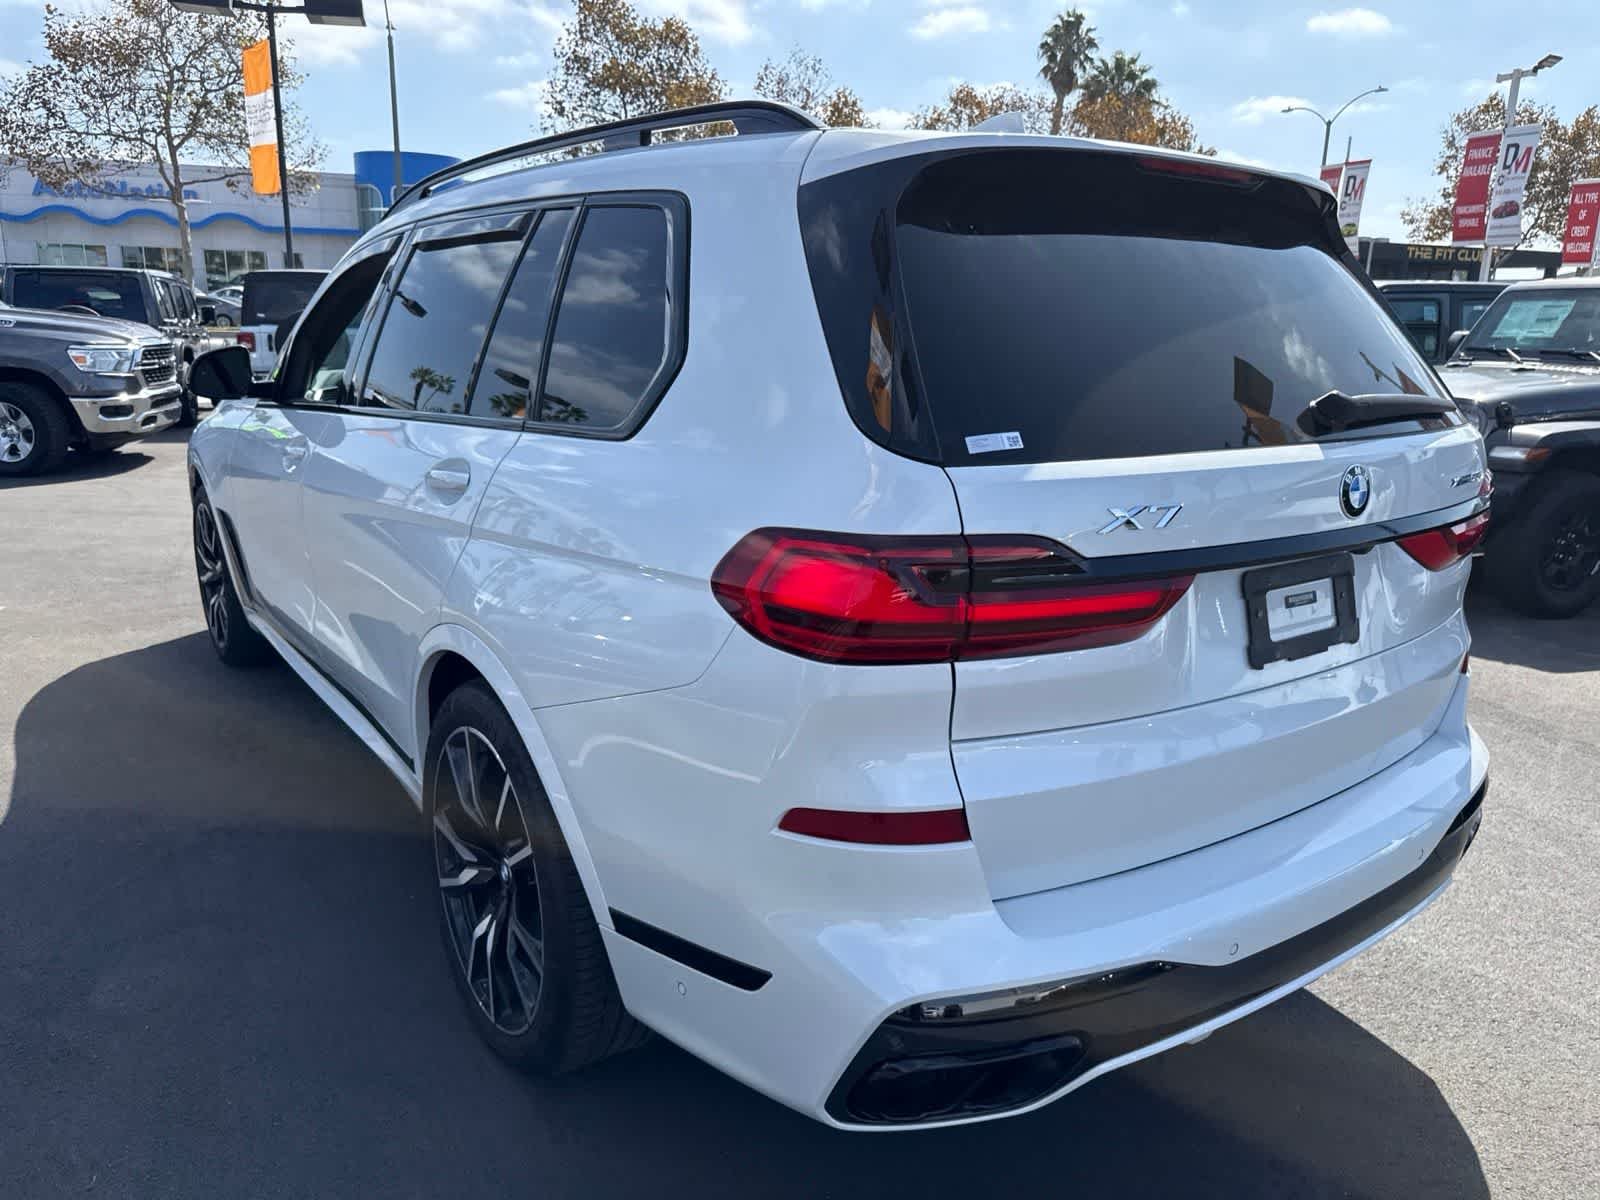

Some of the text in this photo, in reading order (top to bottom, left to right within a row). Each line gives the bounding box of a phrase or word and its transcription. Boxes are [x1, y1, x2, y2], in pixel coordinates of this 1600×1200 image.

[1468, 147, 1494, 160] FINANCE
[1573, 193, 1583, 204] ALL
[1578, 209, 1588, 220] OF
[1571, 226, 1590, 237] CREDIT
[1408, 246, 1432, 259] THE
[1435, 248, 1455, 260] FIT
[1566, 242, 1591, 253] WELCOME
[1096, 502, 1184, 534] X7
